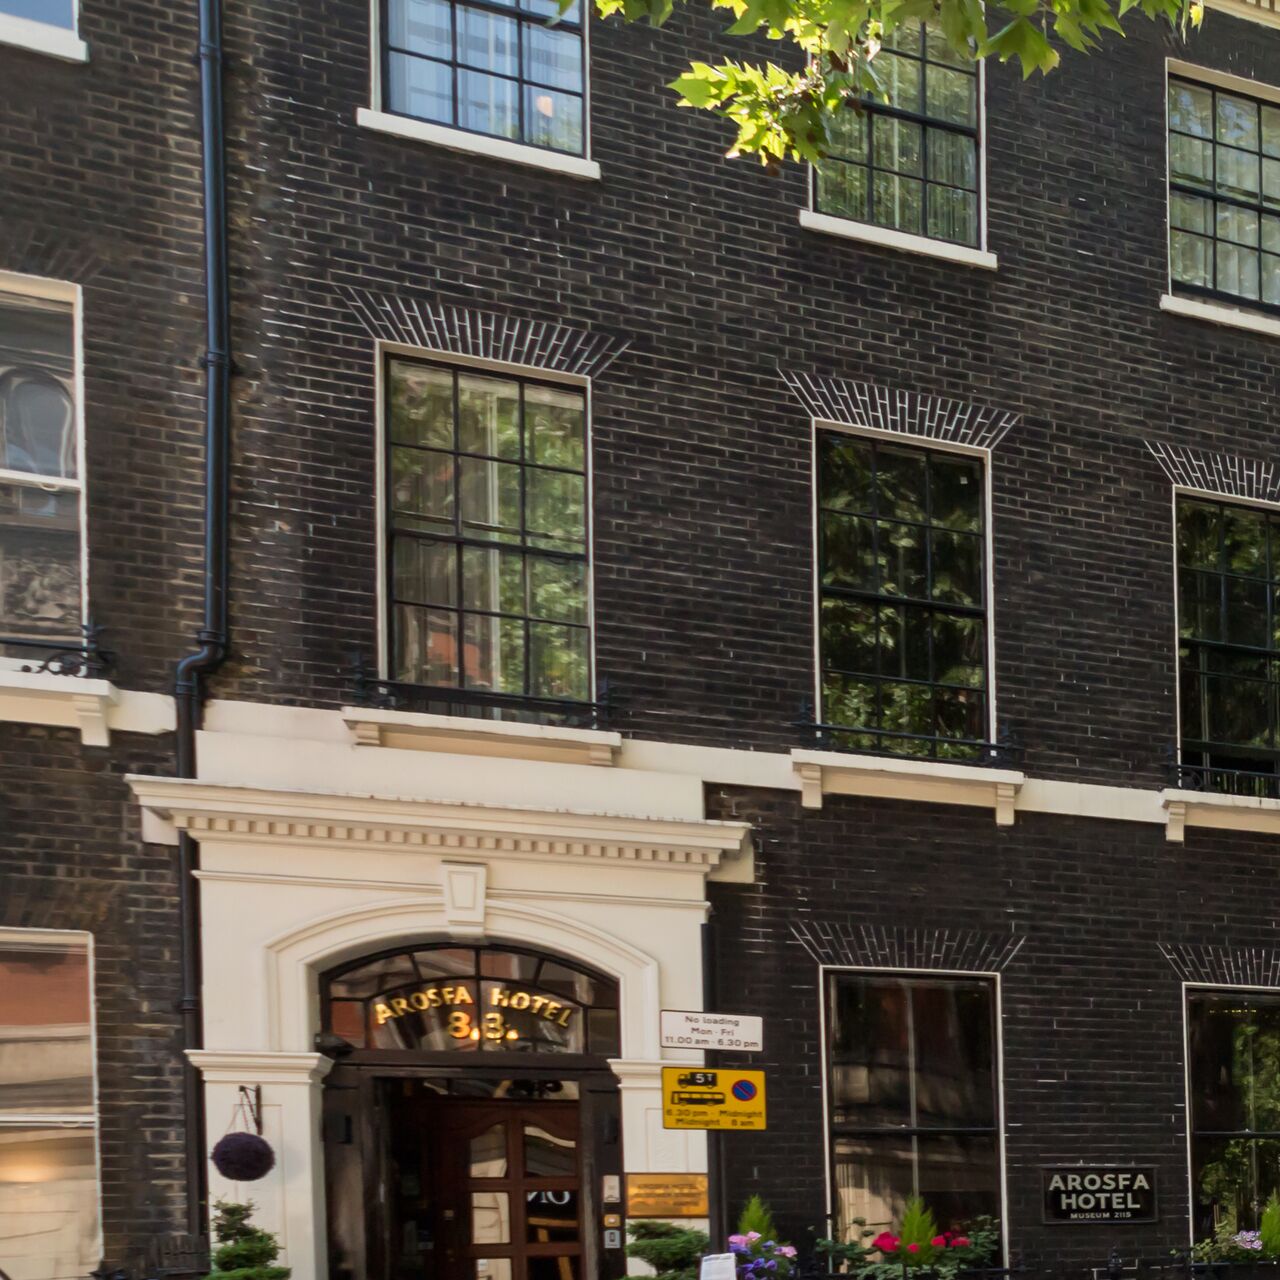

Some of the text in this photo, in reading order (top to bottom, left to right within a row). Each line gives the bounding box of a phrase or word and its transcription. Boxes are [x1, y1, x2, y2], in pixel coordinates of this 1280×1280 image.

[373, 986, 573, 1027] AROSFA HOTEL
[685, 1016, 740, 1027] No loading
[690, 1027, 713, 1035] Mon
[720, 1028, 735, 1036] Fri
[665, 1036, 692, 1044] 11.00
[717, 1039, 742, 1047] 6.30
[1048, 1173, 1151, 1191] AROSFA
[1060, 1192, 1141, 1210] HOTEL
